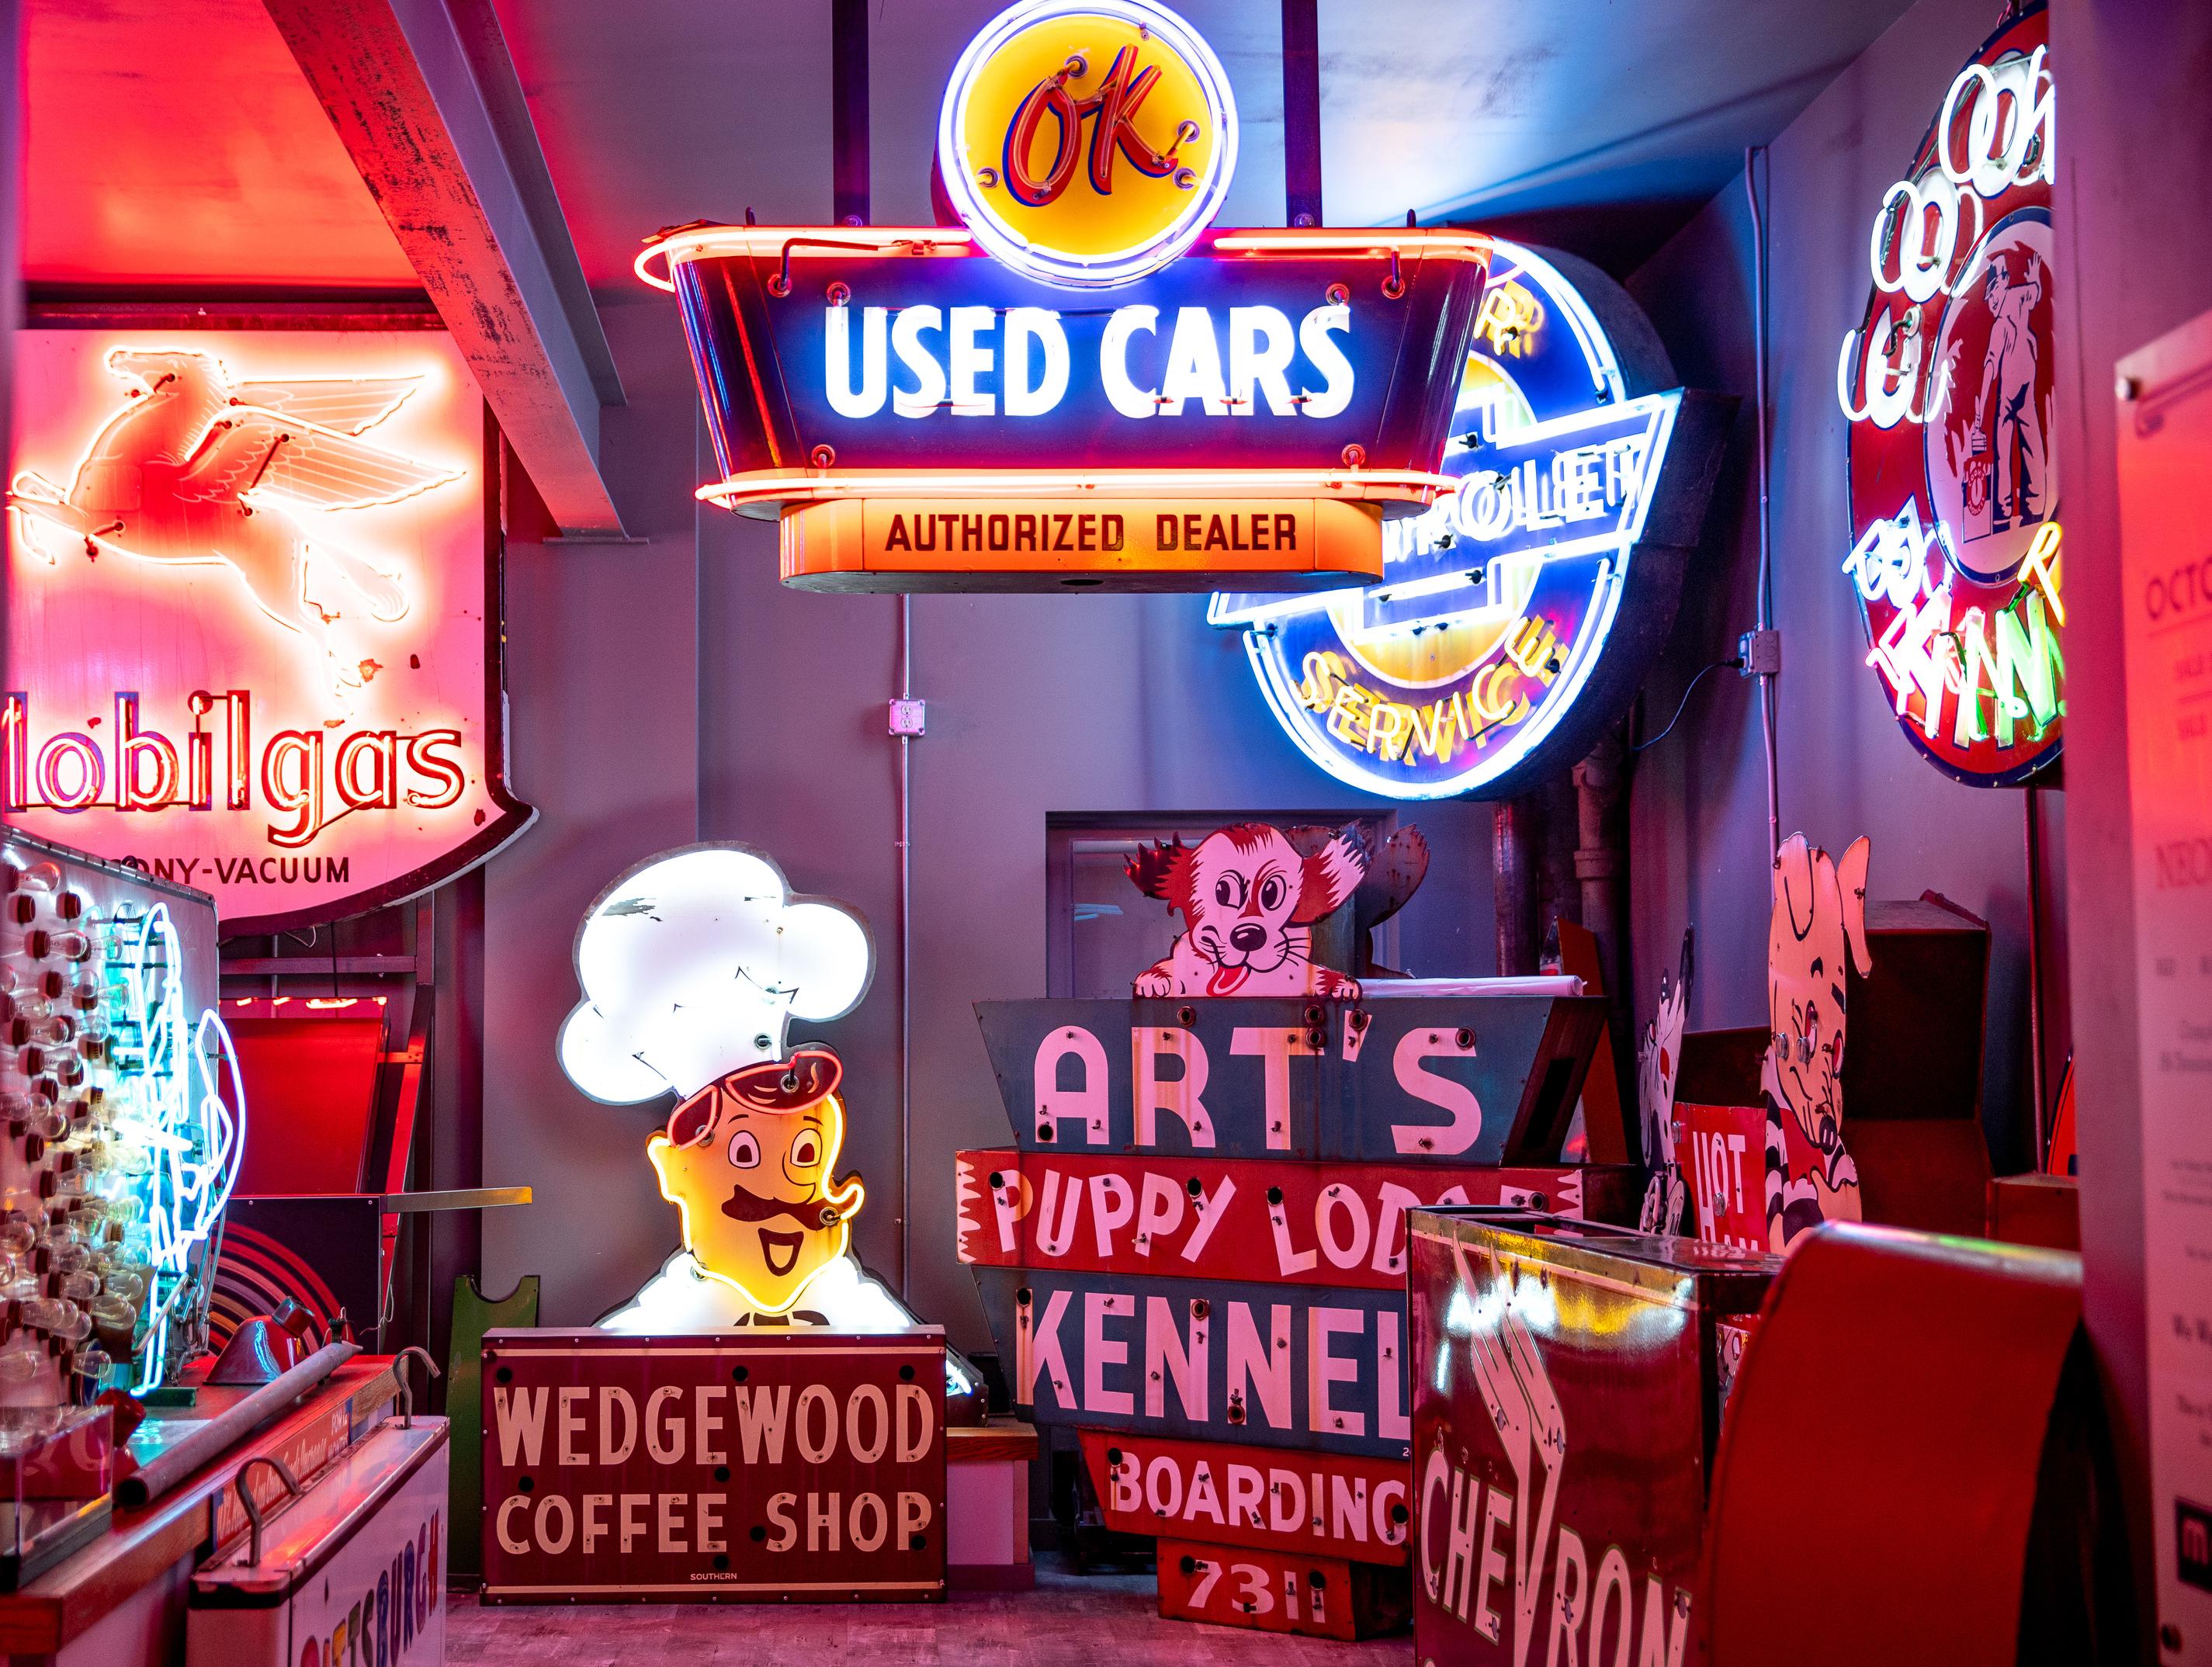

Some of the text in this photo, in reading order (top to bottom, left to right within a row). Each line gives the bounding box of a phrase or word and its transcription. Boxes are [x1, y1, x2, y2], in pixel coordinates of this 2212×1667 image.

[1003, 44, 1178, 207] OK
[825, 305, 1070, 419] USED
[1100, 305, 1355, 420] CARS
[886, 513, 1297, 552] AUTHORIZED DEALER
[1289, 614, 1570, 766] SERVICE
[2, 689, 466, 848] obilgas
[1033, 1010, 1482, 1155] ART'S
[989, 1168, 1541, 1277] PUPPY LOD
[494, 1383, 934, 1467] WEDGEWOOD
[496, 1491, 932, 1554] COFFEE SHOP
[1110, 1450, 1406, 1546] BOARDING
[300, 1507, 439, 1667] TSBURGH
[690, 1572, 737, 1581] SOUTHERN
